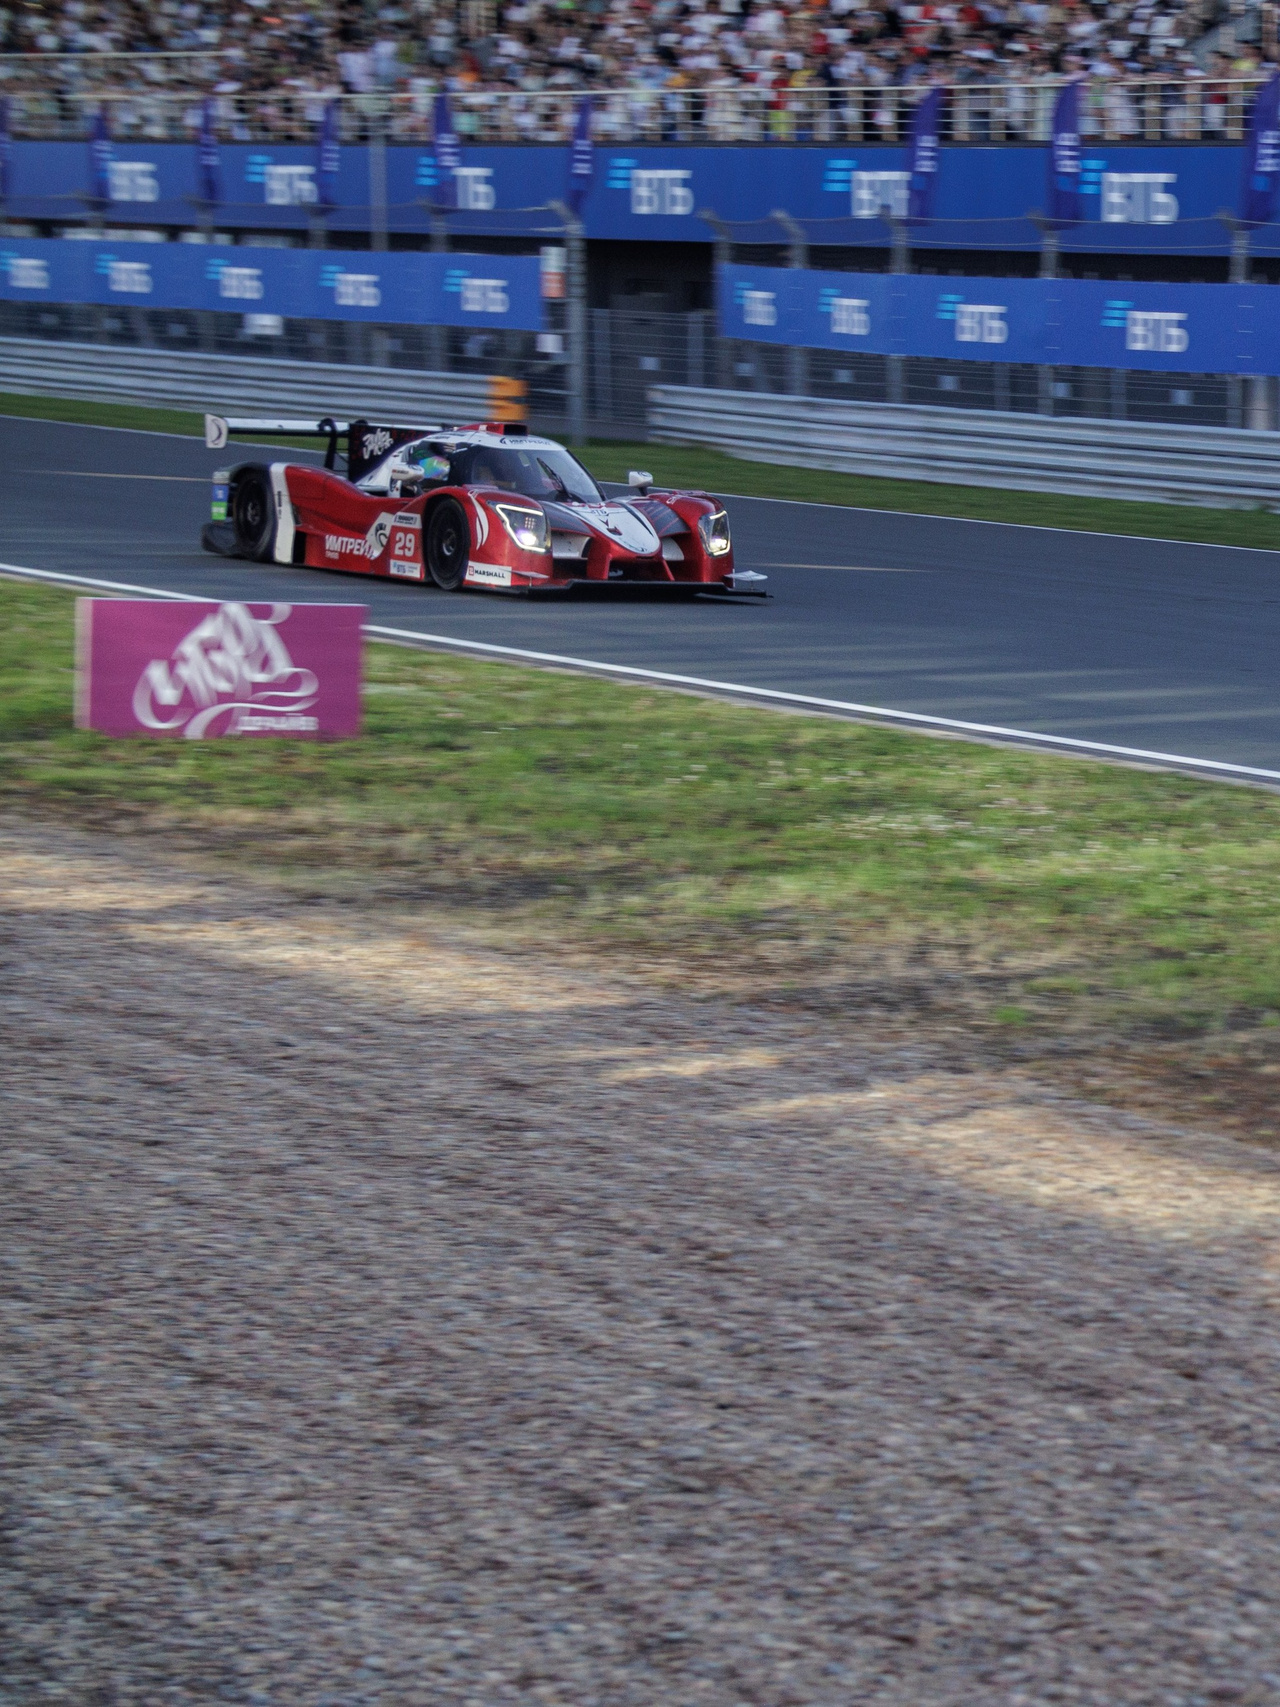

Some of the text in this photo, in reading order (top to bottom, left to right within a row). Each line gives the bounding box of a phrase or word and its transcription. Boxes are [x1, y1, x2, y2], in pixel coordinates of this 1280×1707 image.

[457, 167, 495, 210] ТБ
[1102, 173, 1179, 224] ВТБ
[1126, 311, 1189, 352] ВТБ
[395, 532, 415, 557] 29
[475, 569, 505, 579] MARSHALL
